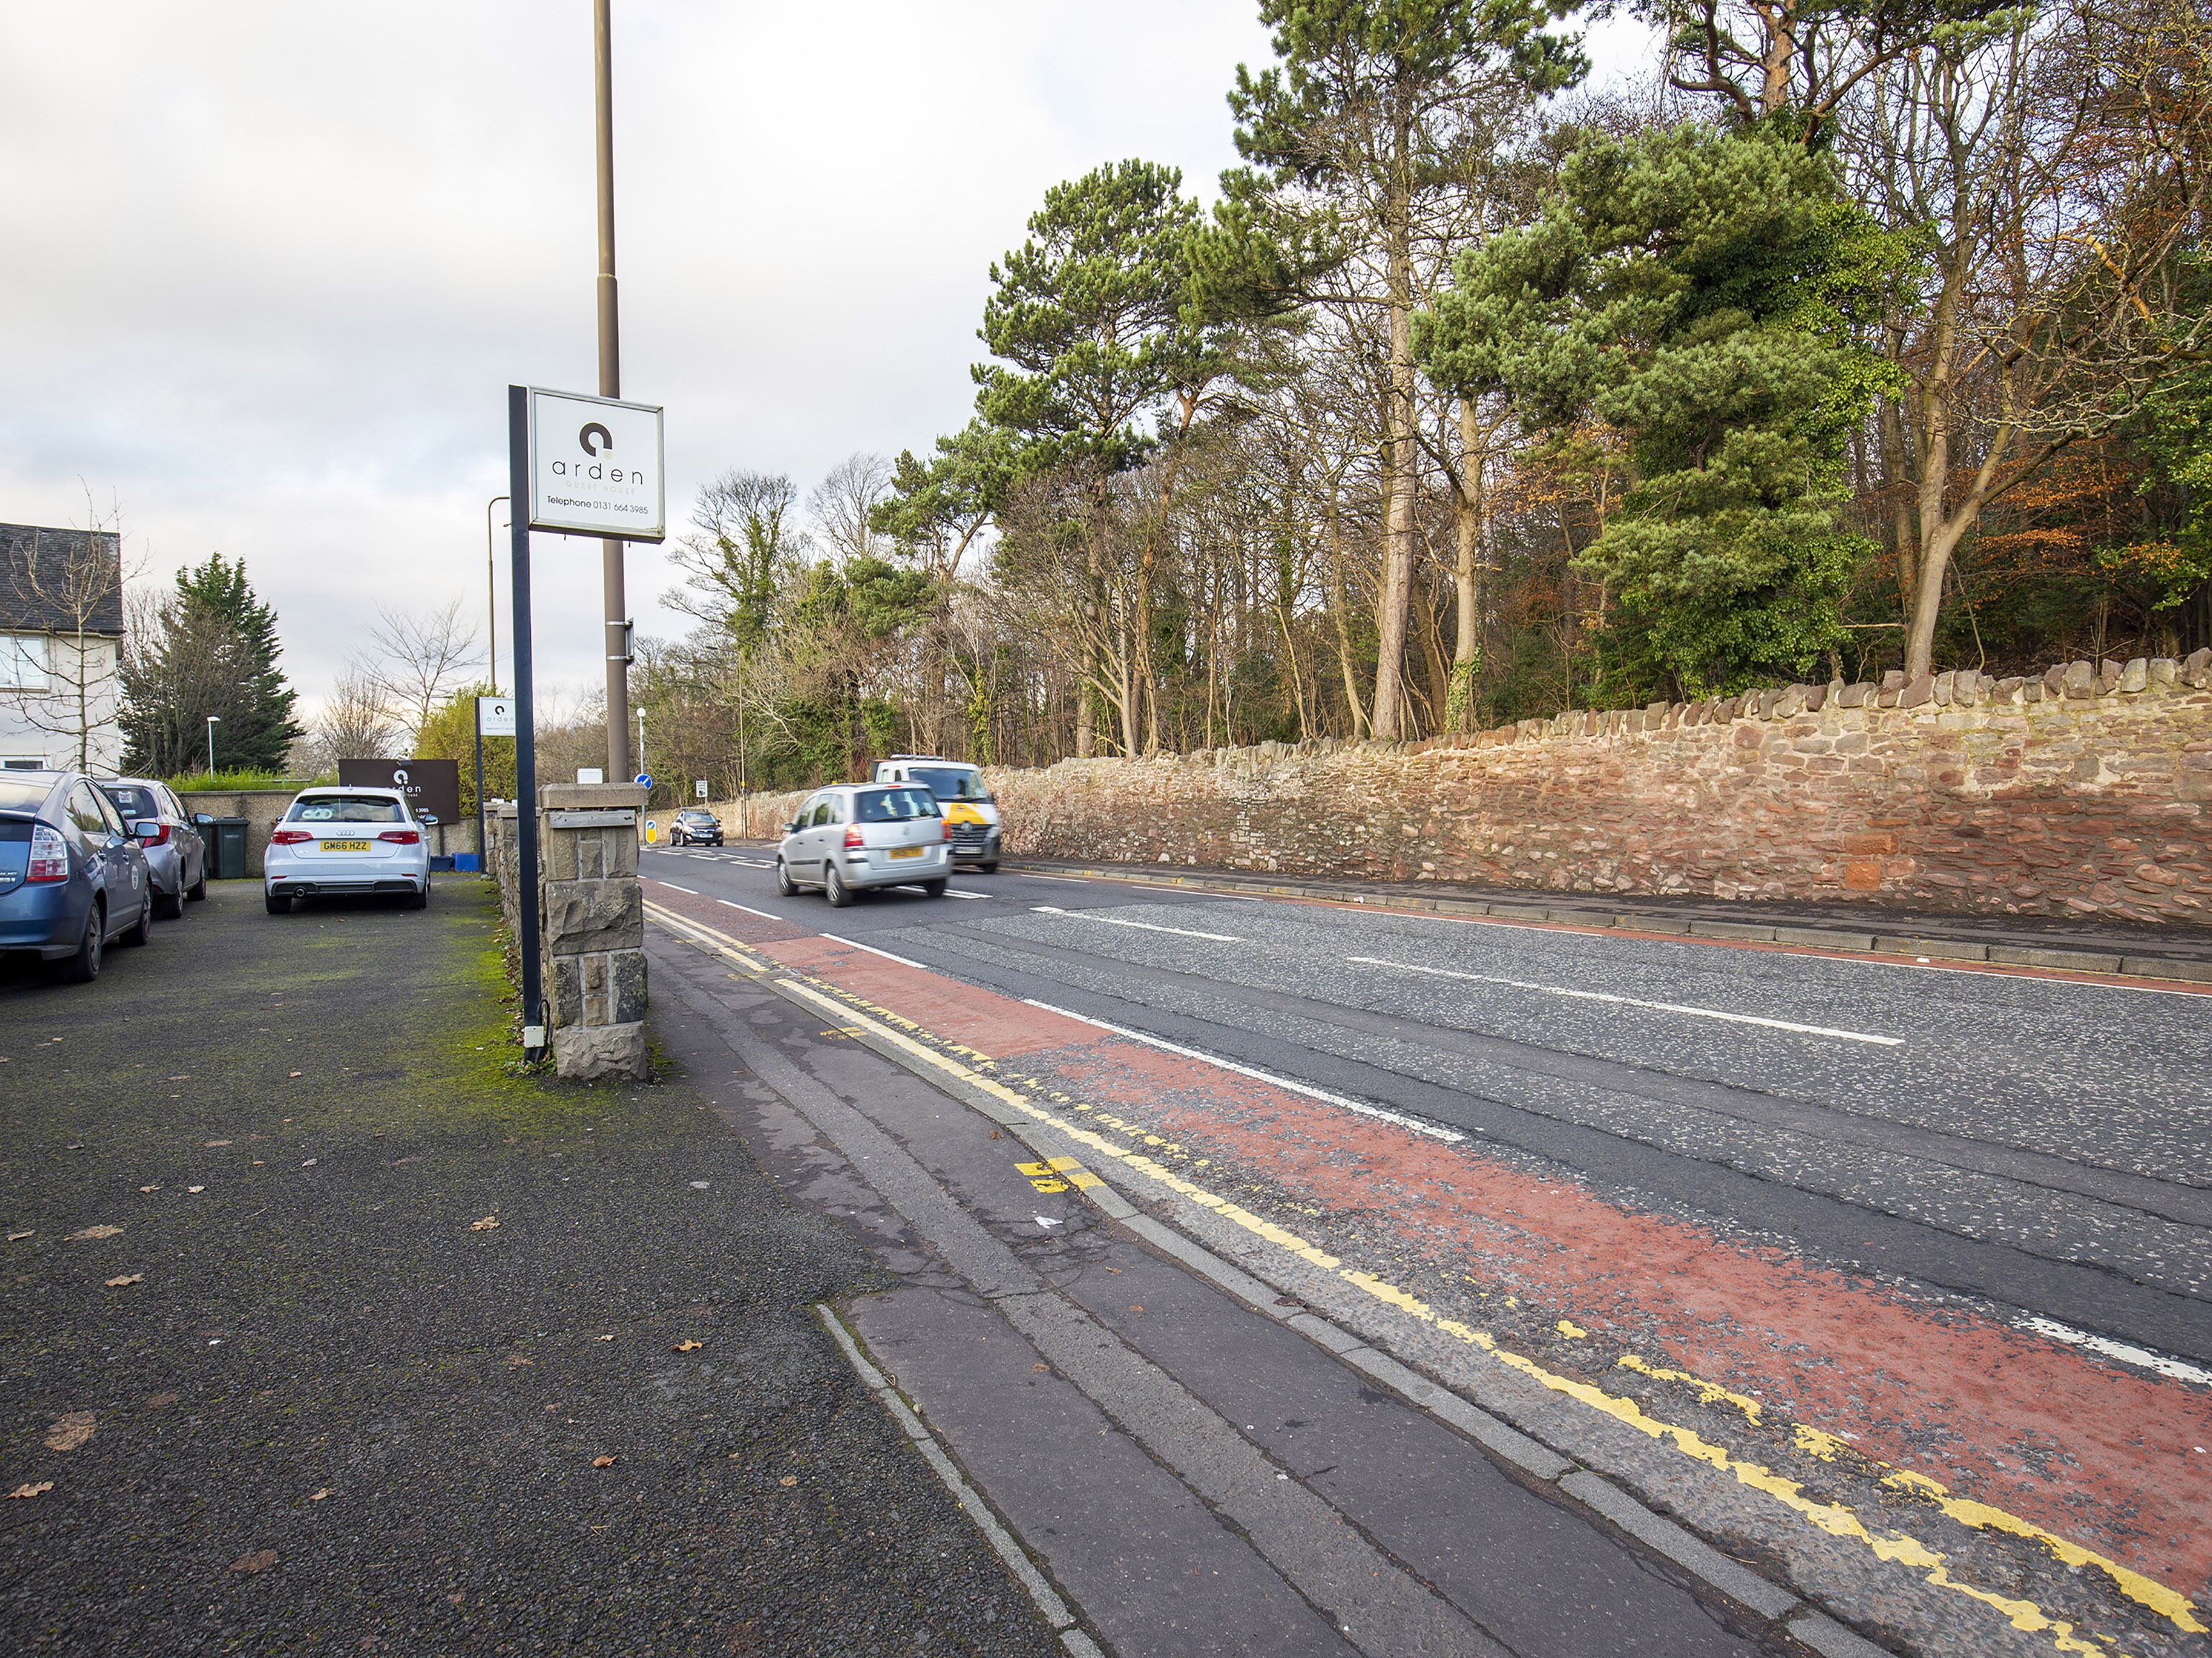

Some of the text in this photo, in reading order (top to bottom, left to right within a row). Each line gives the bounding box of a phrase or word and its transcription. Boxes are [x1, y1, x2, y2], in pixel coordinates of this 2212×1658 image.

[552, 461, 643, 485] arden
[566, 481, 635, 495] GUEST HOUSE
[547, 495, 591, 508] Telephone
[593, 501, 612, 510] 0131
[630, 505, 648, 515] 3985
[324, 841, 367, 850] GM66 HZZ
